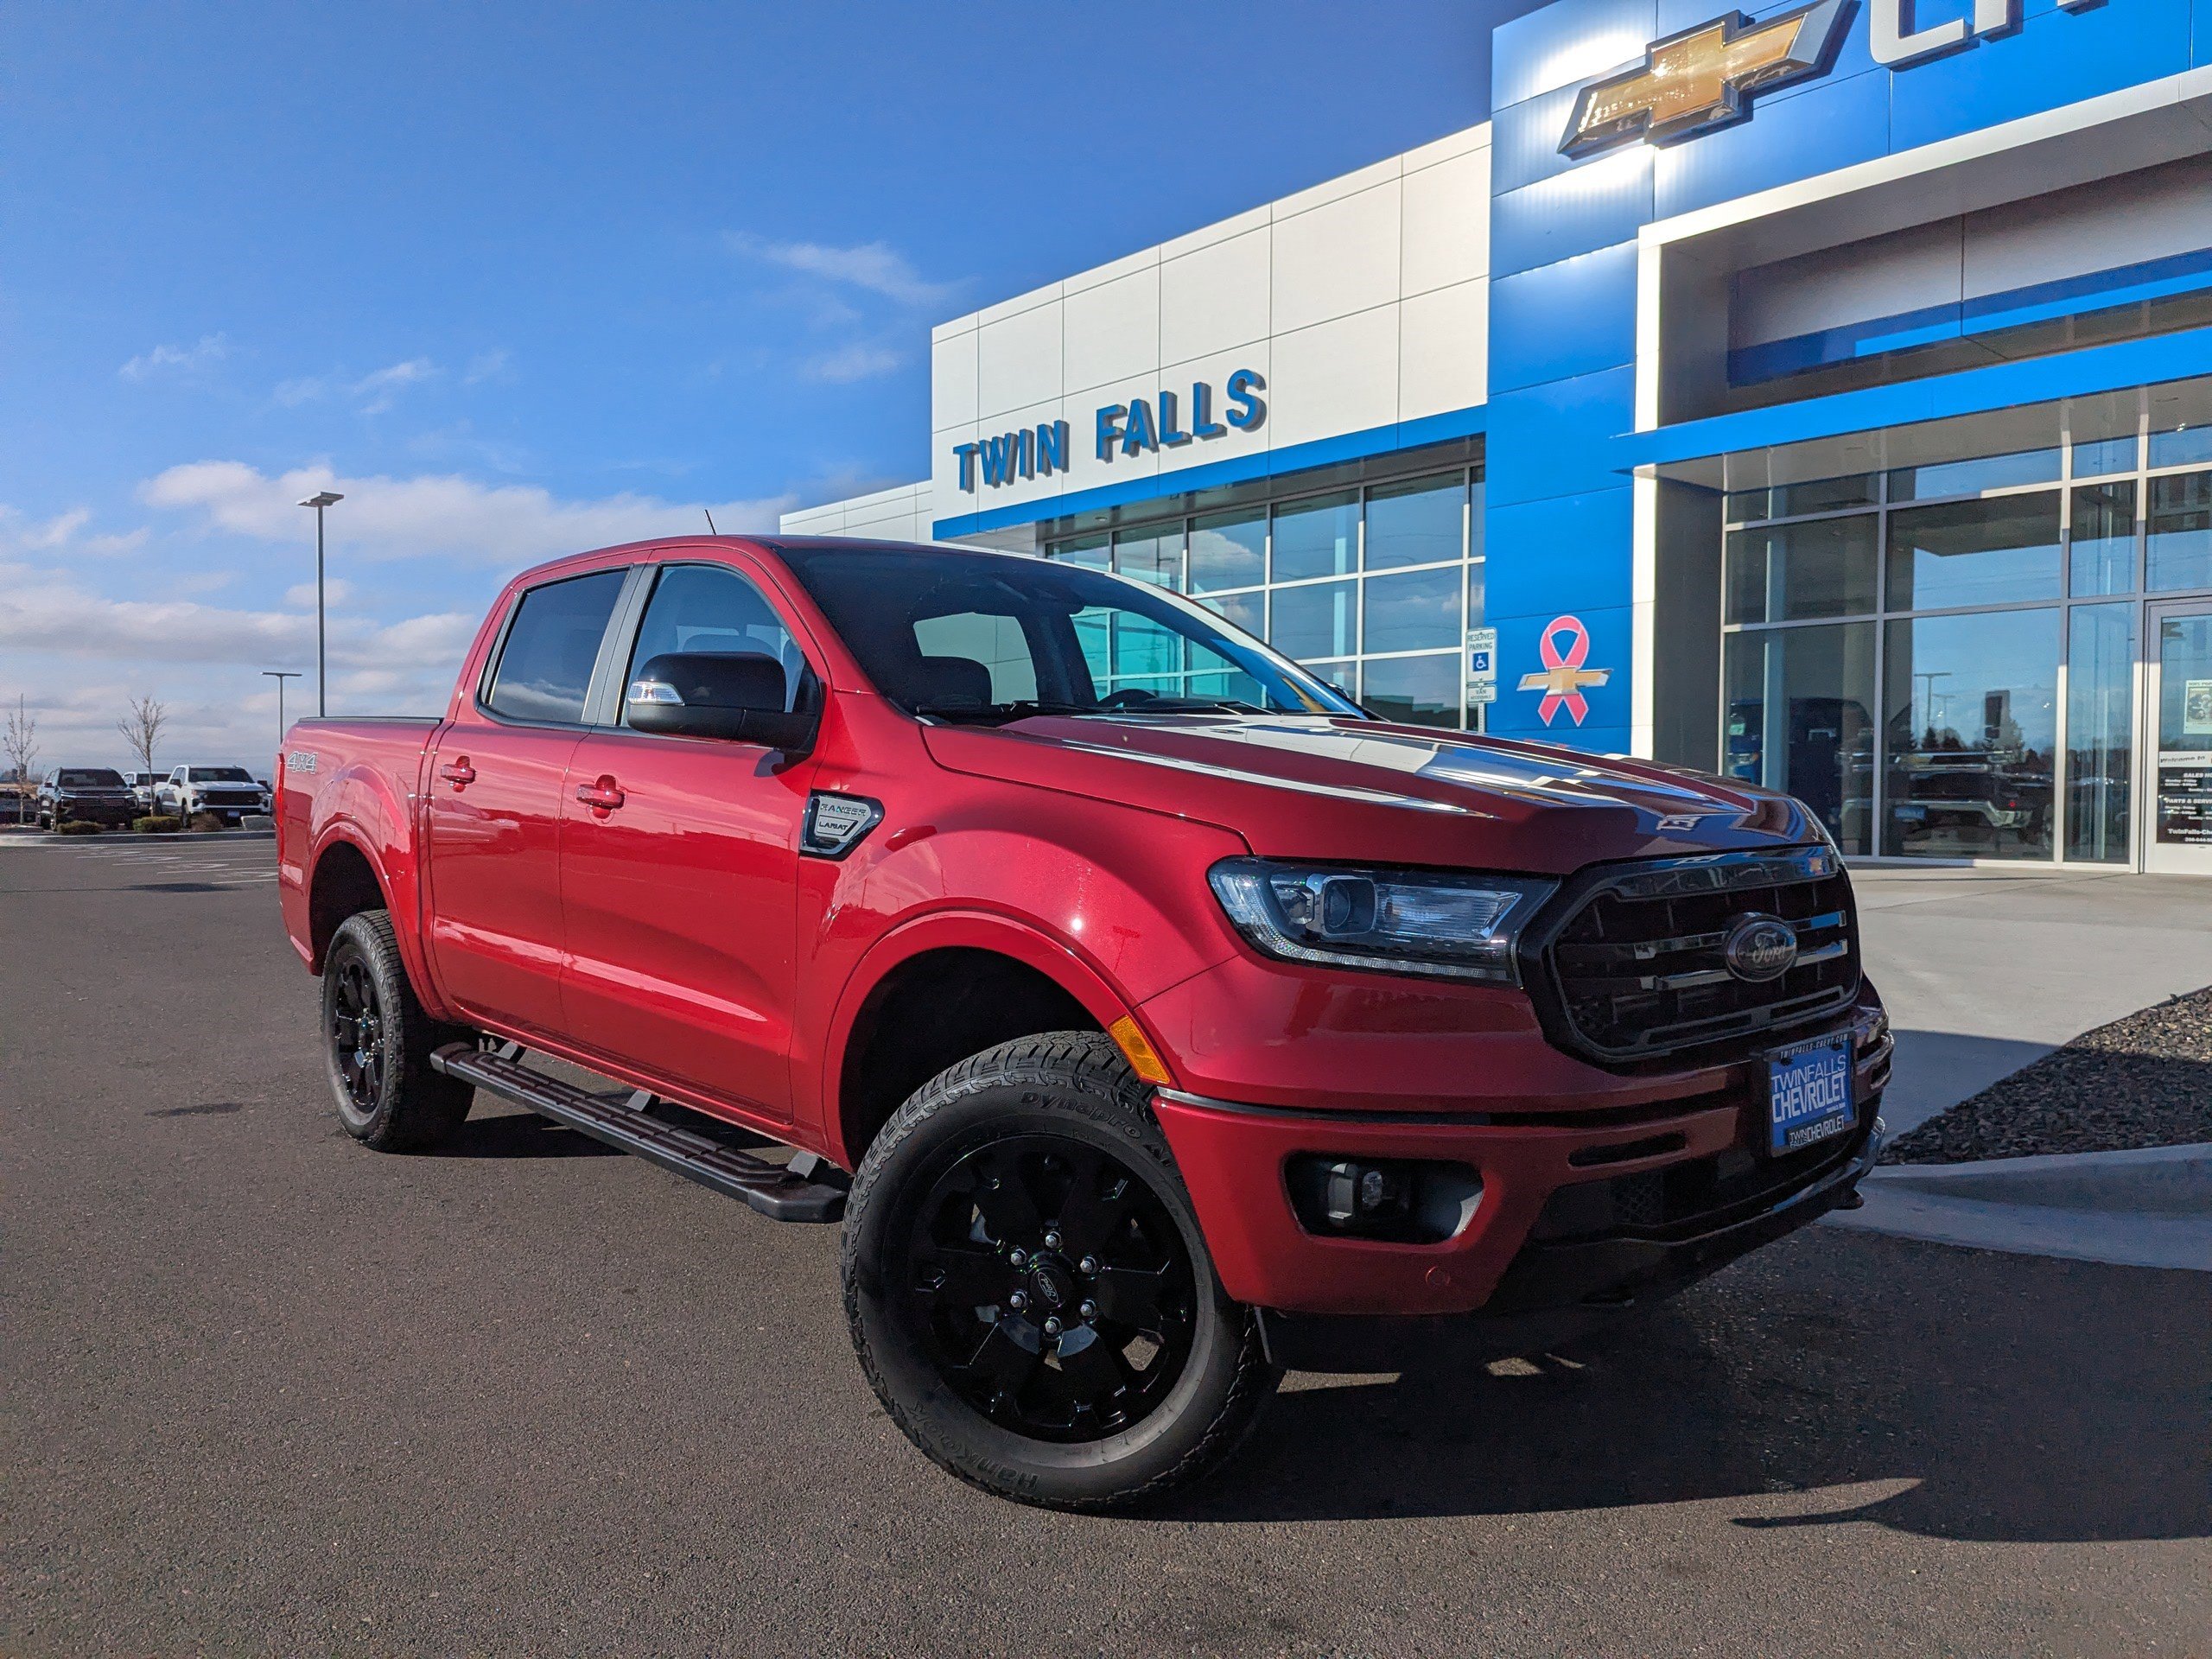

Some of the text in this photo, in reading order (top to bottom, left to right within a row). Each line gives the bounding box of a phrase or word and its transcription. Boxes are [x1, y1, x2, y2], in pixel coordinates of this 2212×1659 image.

[952, 369, 1268, 494] TWIN FALLS
[1467, 632, 1495, 641] RESERVED
[1469, 642, 1492, 651] PARKING
[820, 804, 867, 817] RANGER
[818, 821, 849, 830] LARIAT
[1771, 1071, 1847, 1123] CHEVROLET
[1020, 1091, 1142, 1139] Dynapro
[1789, 1128, 1808, 1141] TWIN
[1807, 1114, 1845, 1142] CHEVROLET
